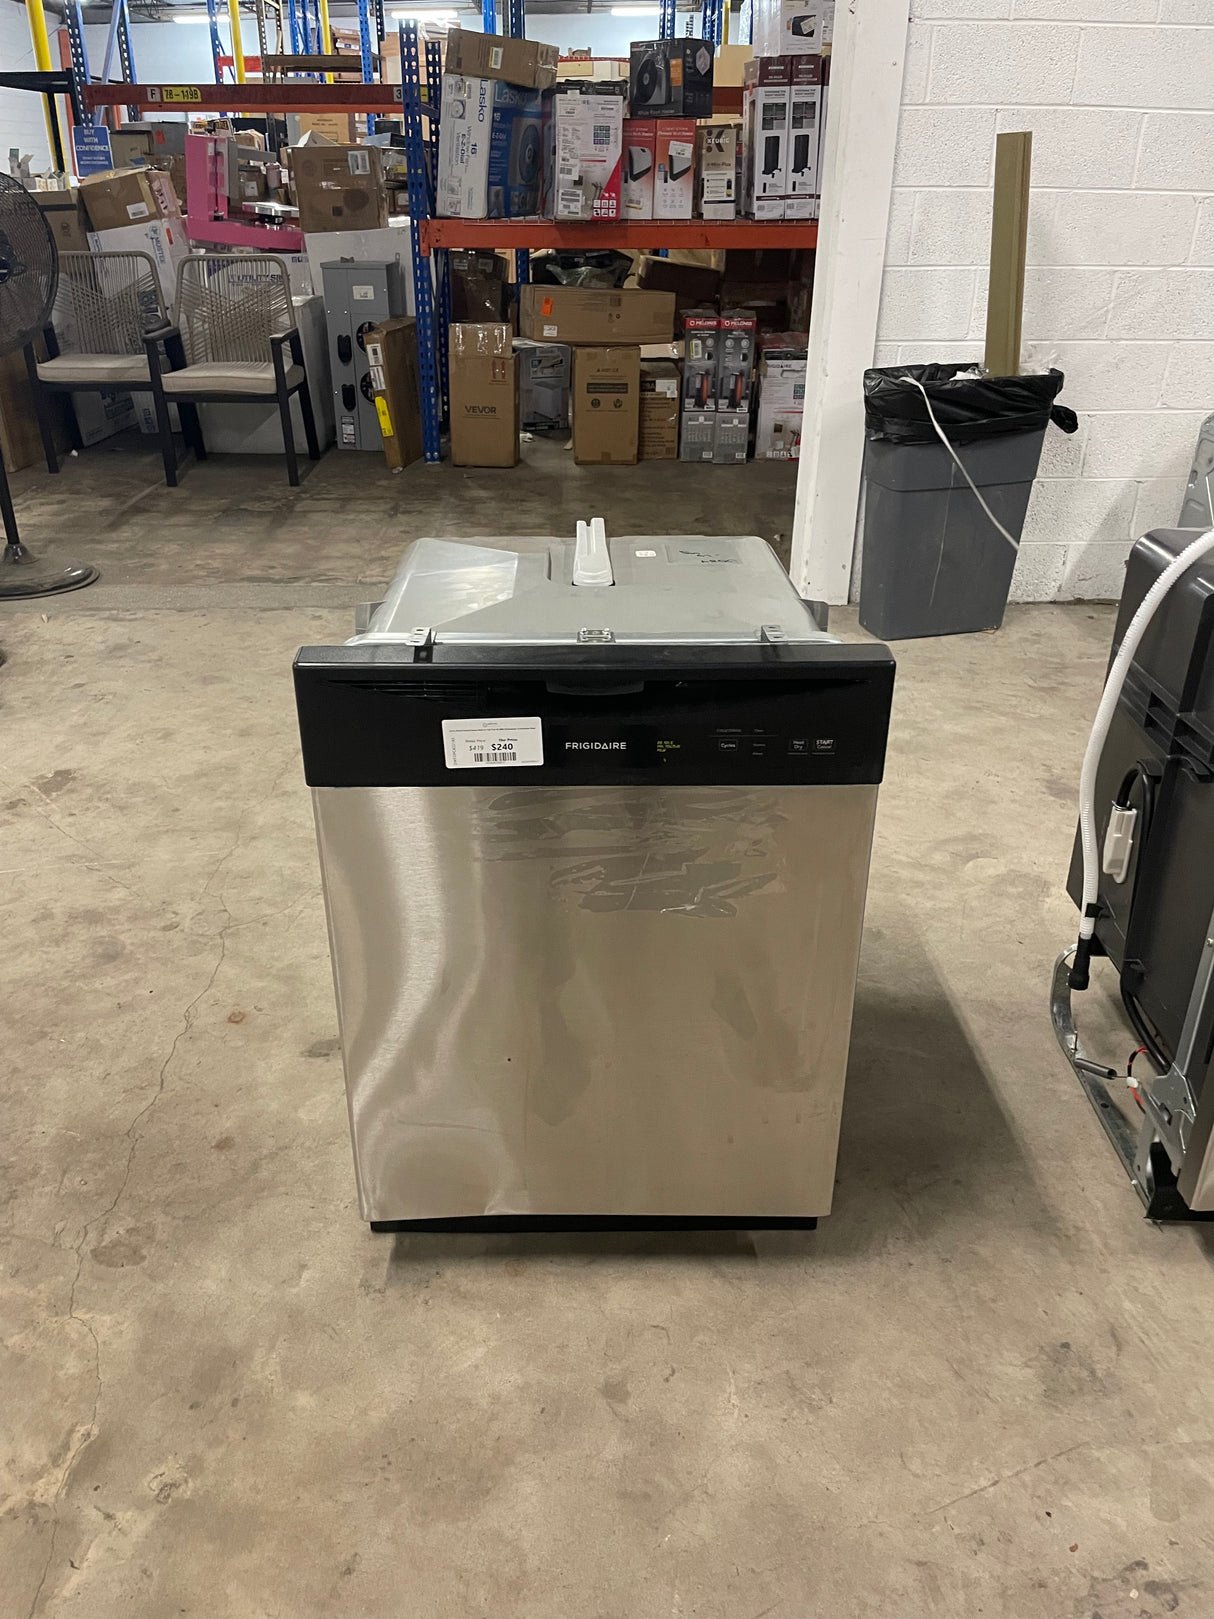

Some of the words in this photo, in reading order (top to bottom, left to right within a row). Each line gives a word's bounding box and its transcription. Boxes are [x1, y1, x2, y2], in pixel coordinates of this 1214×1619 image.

[150, 89, 158, 99] F
[477, 79, 489, 122] Lasko
[465, 405, 497, 414] VEVOR
[490, 743, 514, 751] $240
[565, 742, 627, 750] FRIGIDAIRE
